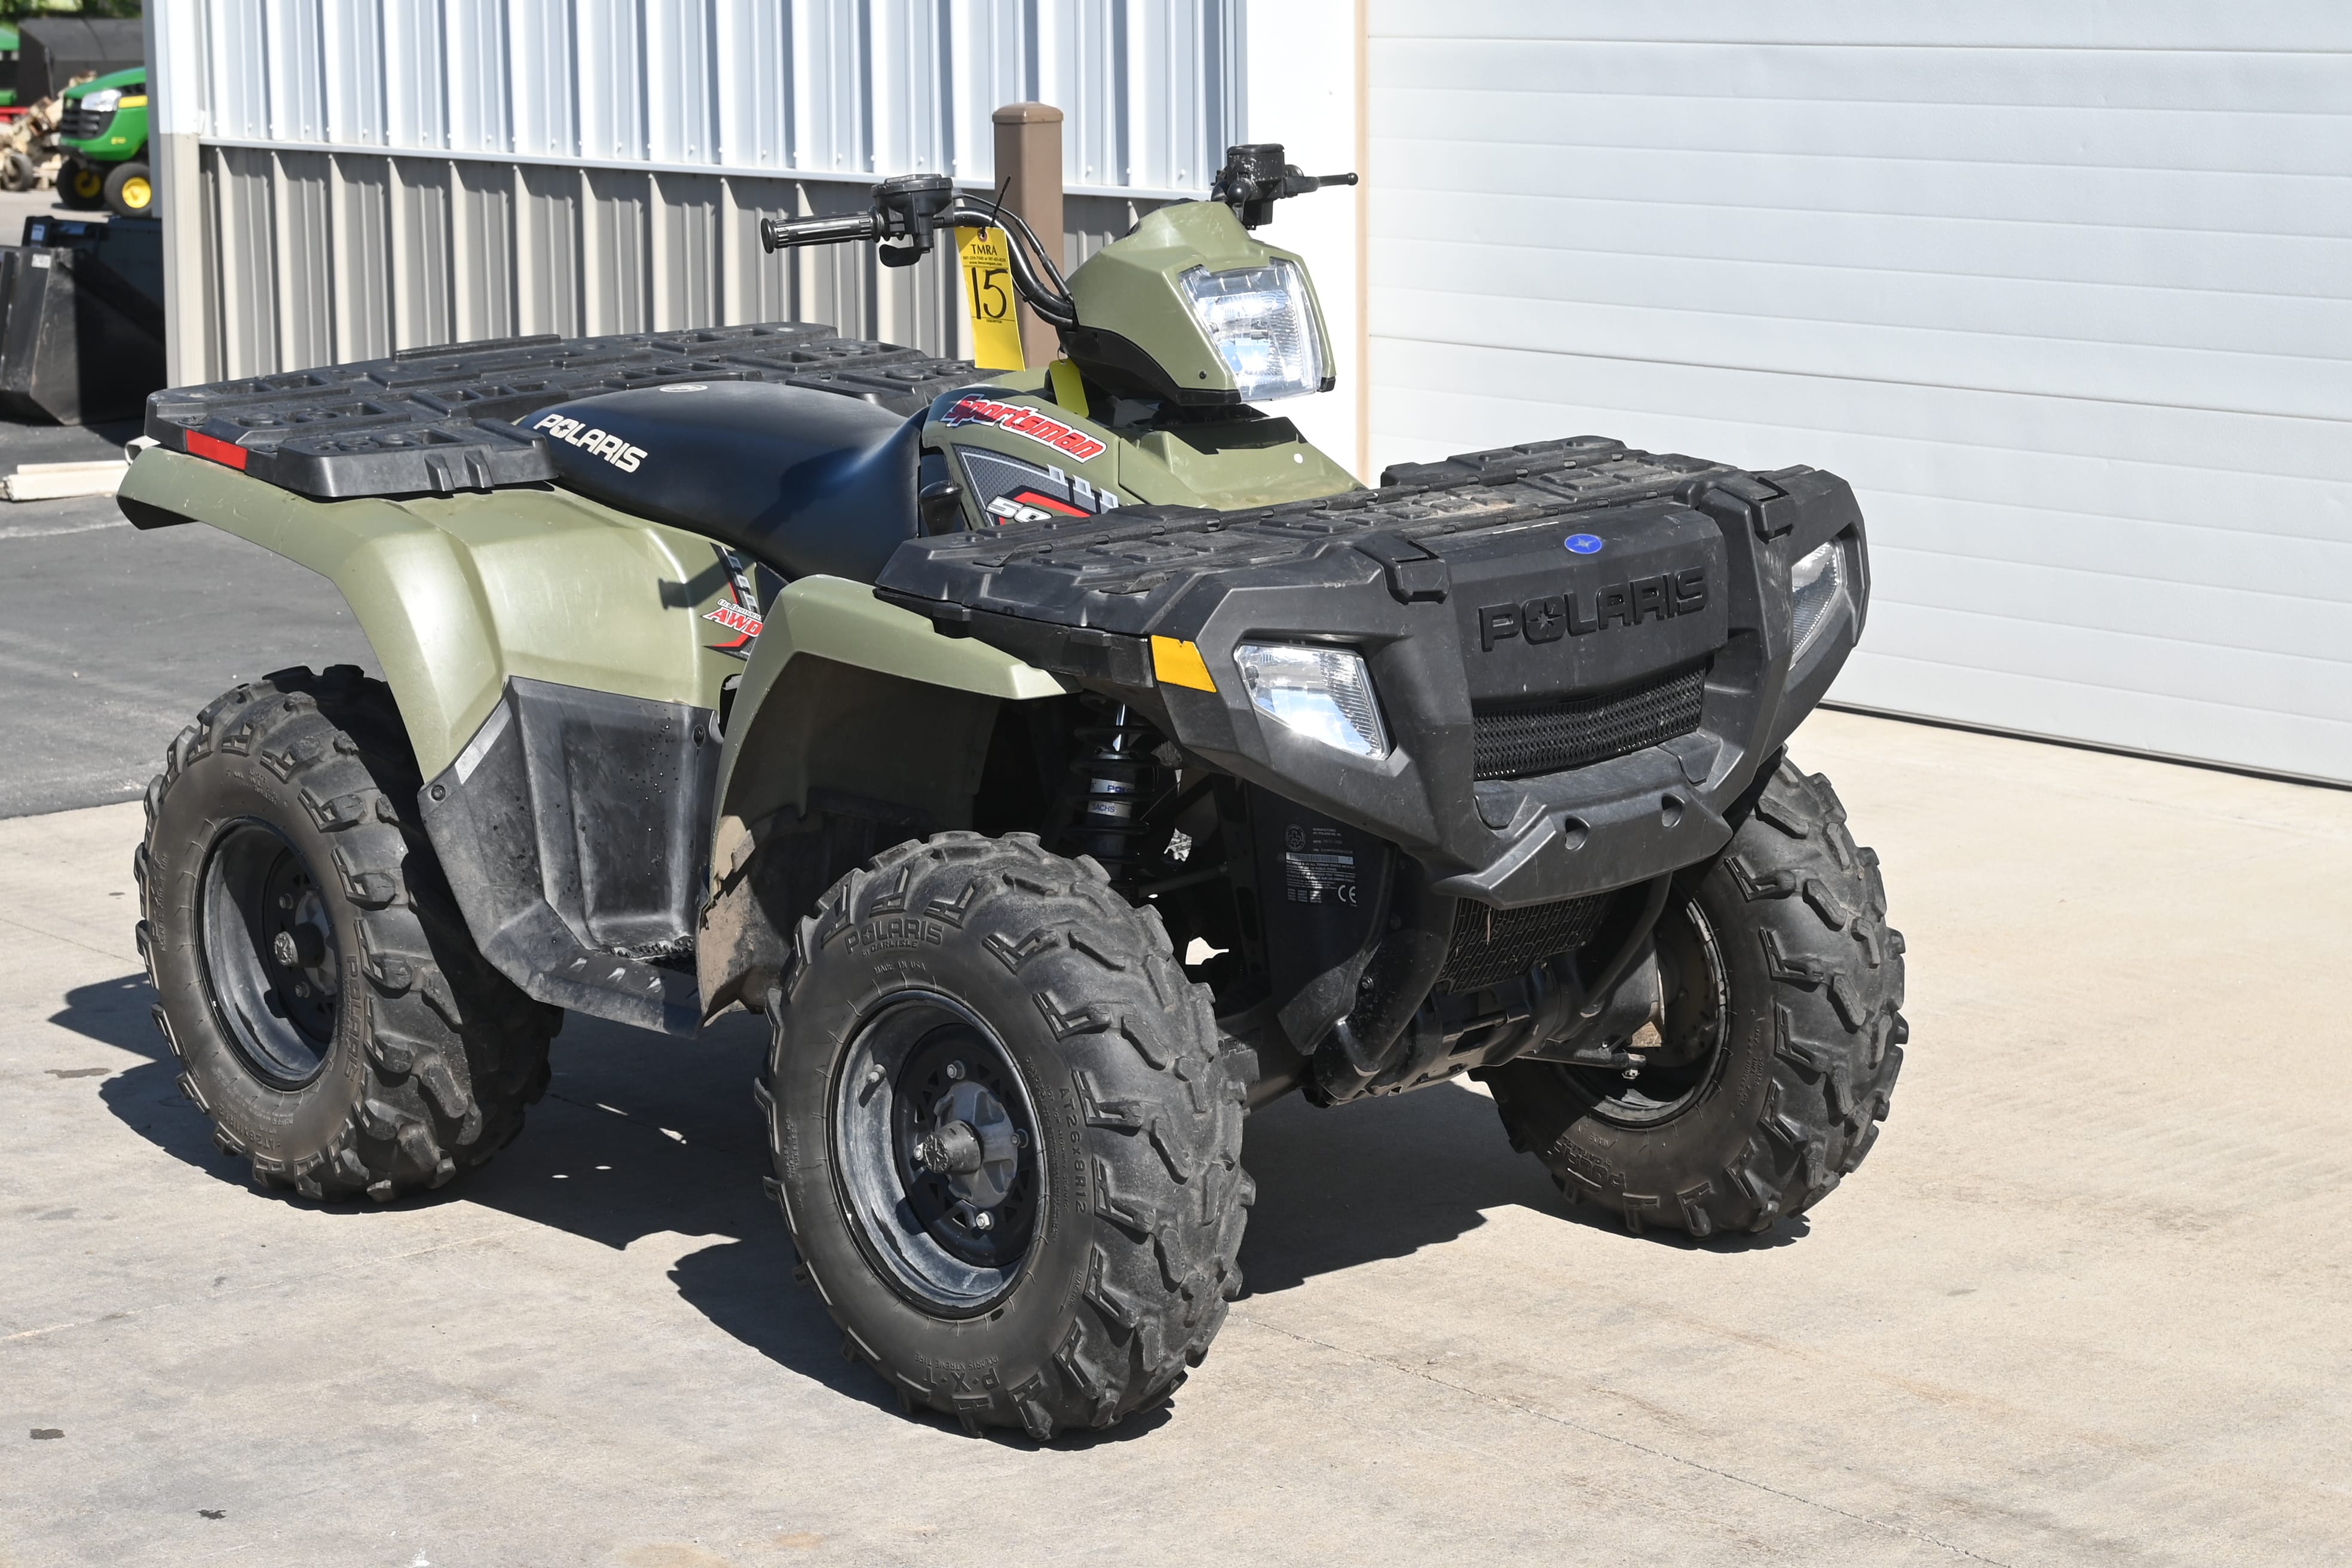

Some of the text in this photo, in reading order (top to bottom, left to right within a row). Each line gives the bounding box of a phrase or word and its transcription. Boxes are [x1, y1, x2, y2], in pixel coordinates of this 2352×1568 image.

[970, 244, 997, 255] TMRA
[972, 267, 1008, 319] 15
[533, 414, 648, 473] POLARIS
[941, 394, 1106, 463] Sportsman
[705, 608, 763, 637] AWD
[1478, 566, 1708, 652] POLARIS
[1092, 803, 1115, 813] SACHS
[845, 918, 943, 955] POLARIS
[870, 940, 918, 953] CARLISLE
[898, 960, 908, 970] IN
[909, 961, 927, 971] USA
[344, 956, 362, 1082] POLARIS
[914, 1353, 999, 1371] POLARIS XTREME TIRE
